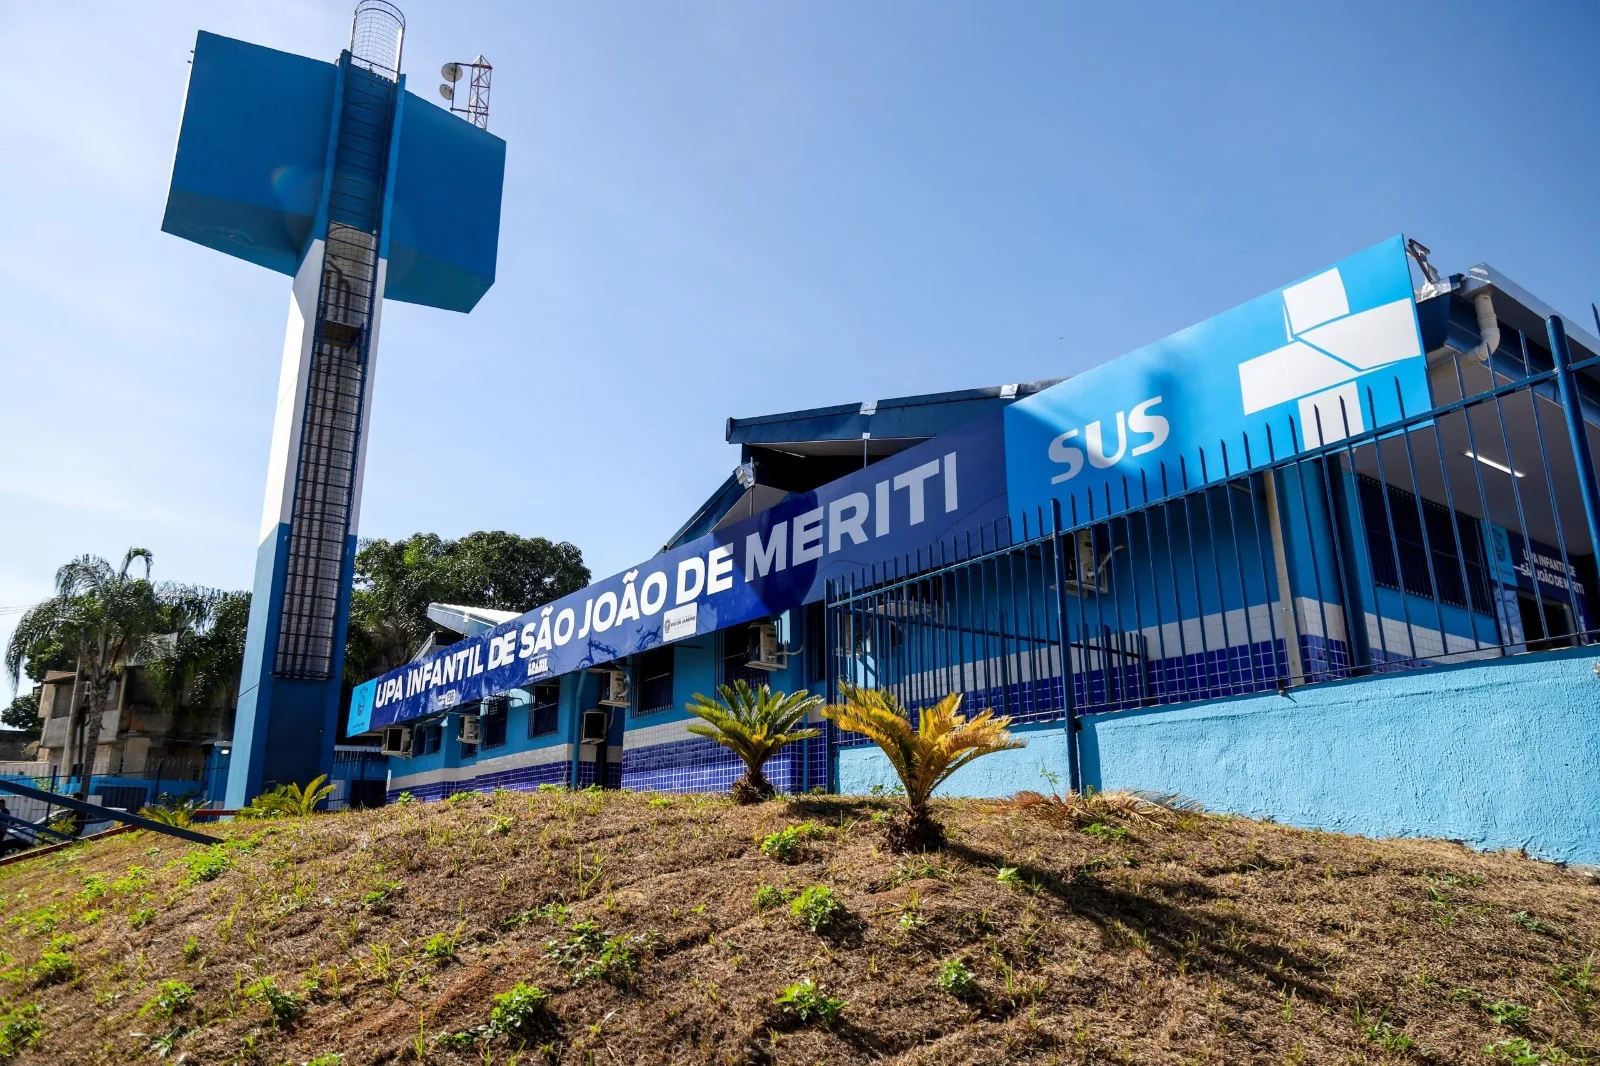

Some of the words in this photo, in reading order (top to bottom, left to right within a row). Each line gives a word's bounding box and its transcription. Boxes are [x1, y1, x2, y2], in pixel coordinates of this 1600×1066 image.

[1048, 395, 1170, 485] SUS
[375, 675, 403, 708] UPA
[406, 644, 484, 698] INFANTIL
[487, 630, 517, 671] DE
[518, 604, 575, 659] SÃO
[578, 568, 668, 639] JOÃO
[676, 542, 734, 605] DE
[744, 451, 960, 583] MERITI
